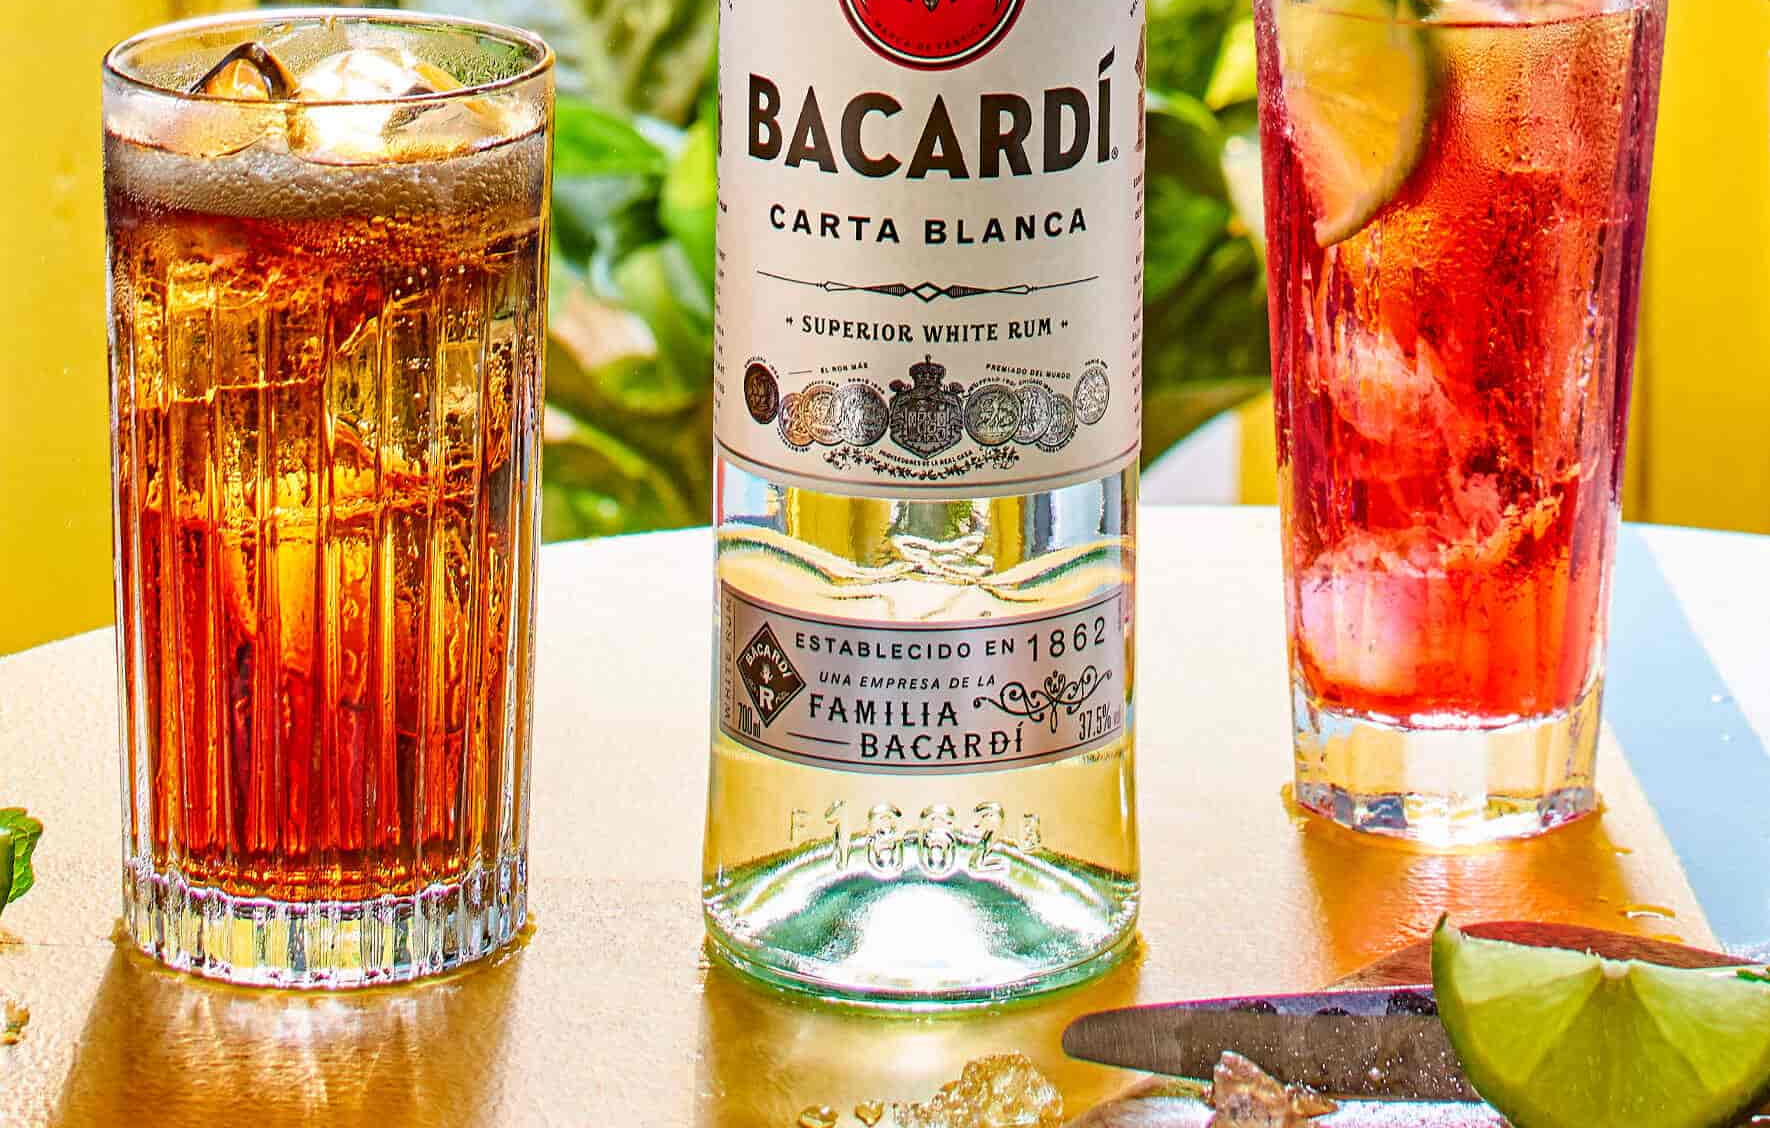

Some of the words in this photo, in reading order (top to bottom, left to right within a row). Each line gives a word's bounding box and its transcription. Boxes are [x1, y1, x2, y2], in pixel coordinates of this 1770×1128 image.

[748, 45, 1116, 180] BACARDÍ
[770, 203, 900, 244] CARTA
[924, 207, 1087, 245] BLANCA
[801, 315, 914, 343] SUPERIOR
[923, 318, 999, 344] WHITE
[1007, 317, 1053, 340] RUM
[795, 632, 971, 660] ESTABLECIDO
[985, 638, 1015, 657] EN
[1027, 615, 1106, 663] 1862
[759, 684, 774, 712] R
[818, 671, 852, 687] UNA
[859, 675, 942, 691] EMPRESA
[948, 675, 971, 690] DE
[977, 673, 997, 688] LA
[809, 692, 960, 729] FAMILIA
[1078, 702, 1113, 742] 37.5%
[859, 720, 1024, 760] BACARDÍ
